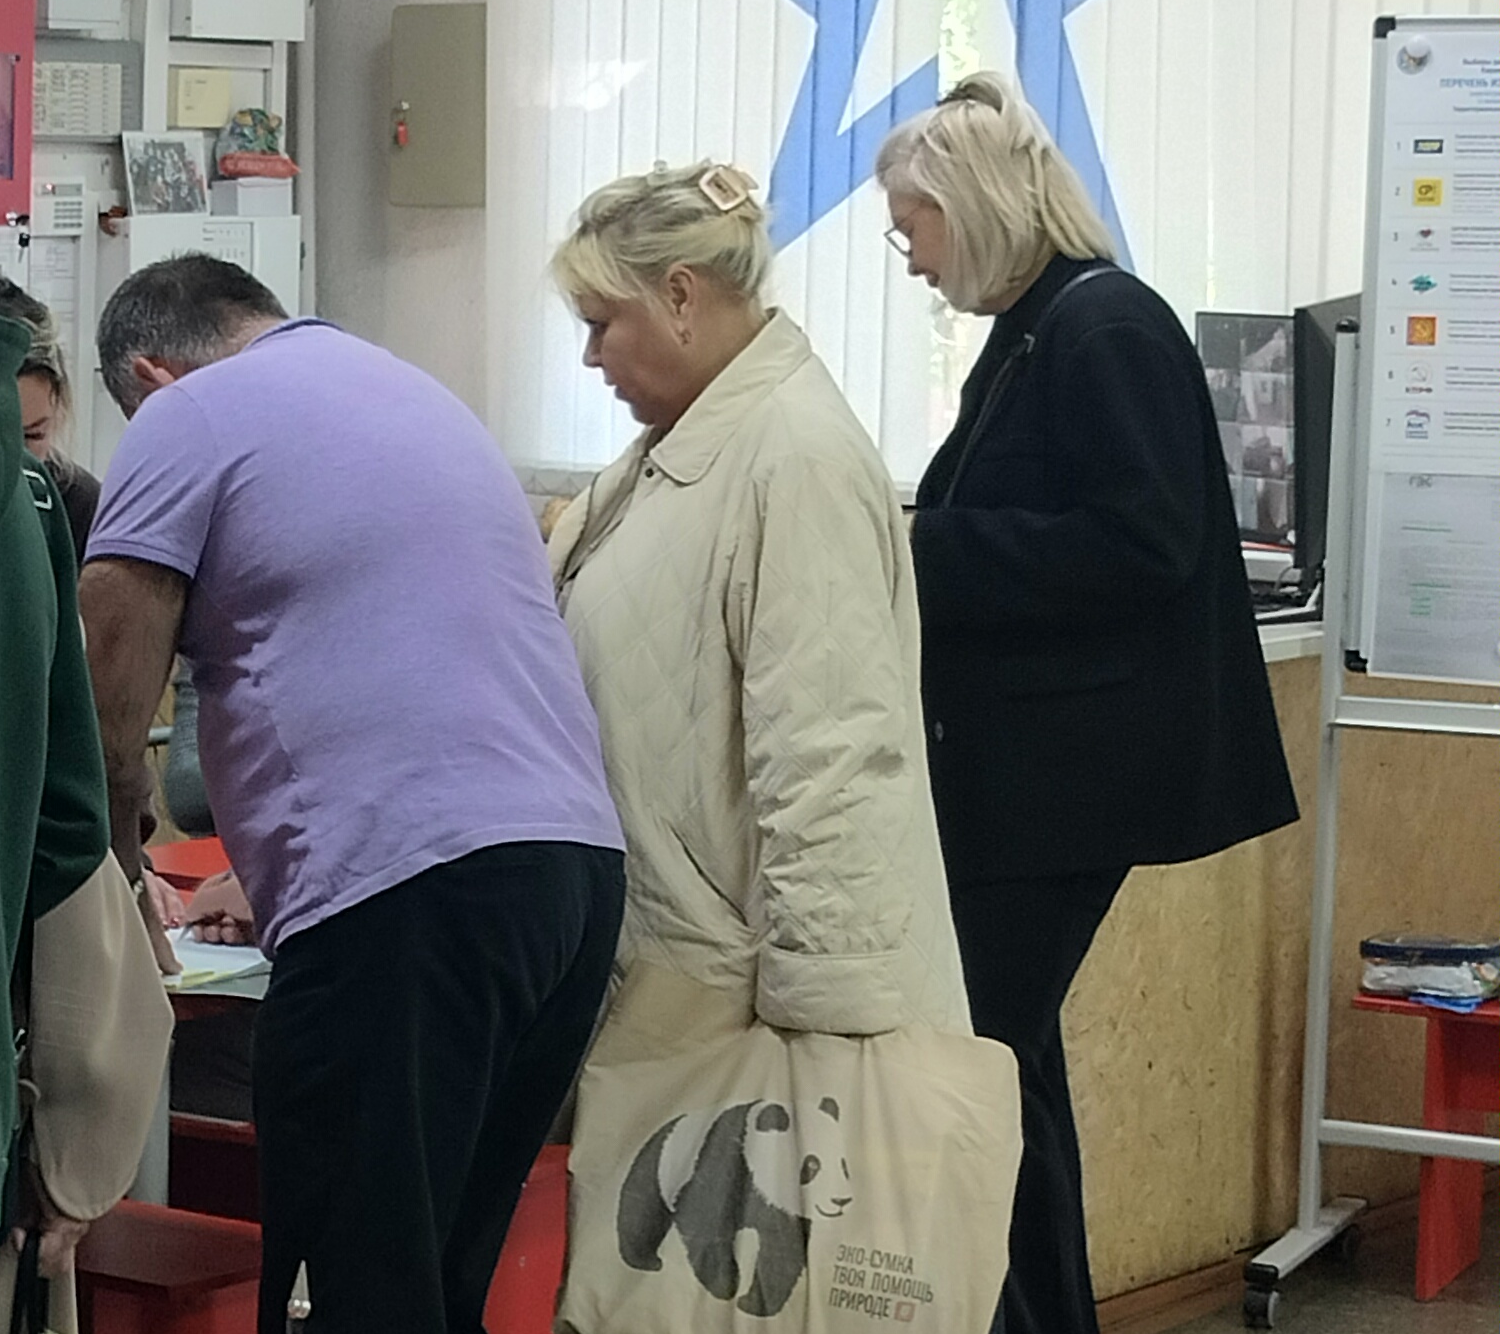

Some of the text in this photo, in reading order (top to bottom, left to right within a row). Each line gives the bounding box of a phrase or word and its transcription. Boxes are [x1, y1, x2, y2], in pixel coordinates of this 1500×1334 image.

[835, 1244, 914, 1275] ЭКО-СУМКА
[832, 1264, 934, 1305] ТВОЯ ПОМОЩЬ
[828, 1286, 893, 1320] ПРИРОДЕ
